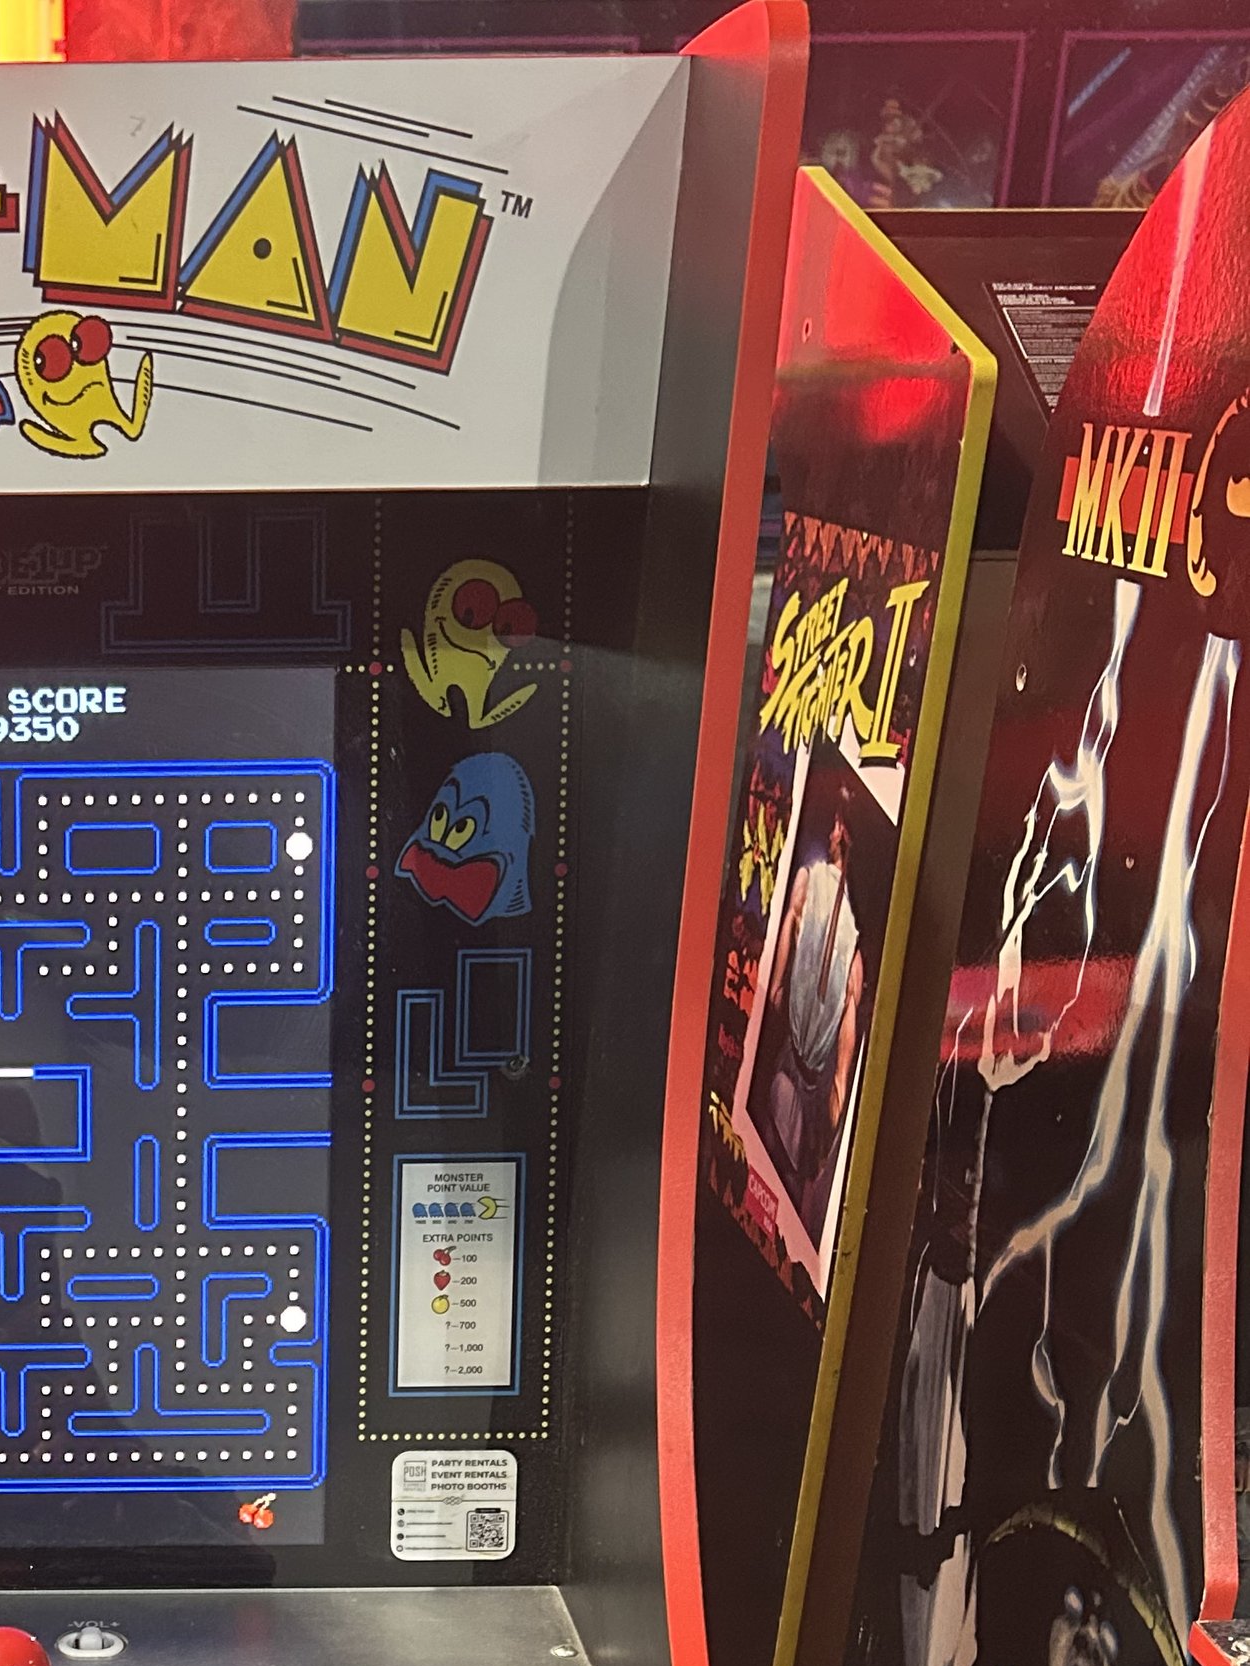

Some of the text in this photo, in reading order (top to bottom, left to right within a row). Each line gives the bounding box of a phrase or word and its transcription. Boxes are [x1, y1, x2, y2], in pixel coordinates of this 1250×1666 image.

[7, 585, 80, 596] EDITION
[759, 577, 849, 736] STREET
[774, 616, 875, 756] FIGHTER
[7, 686, 127, 714] SCORE
[434, 1173, 484, 1183] MONSTER
[427, 1183, 491, 1193] POINT VALUE
[422, 1233, 494, 1243] EXTRA POINTS
[466, 1482, 508, 1490] BOOTHS
